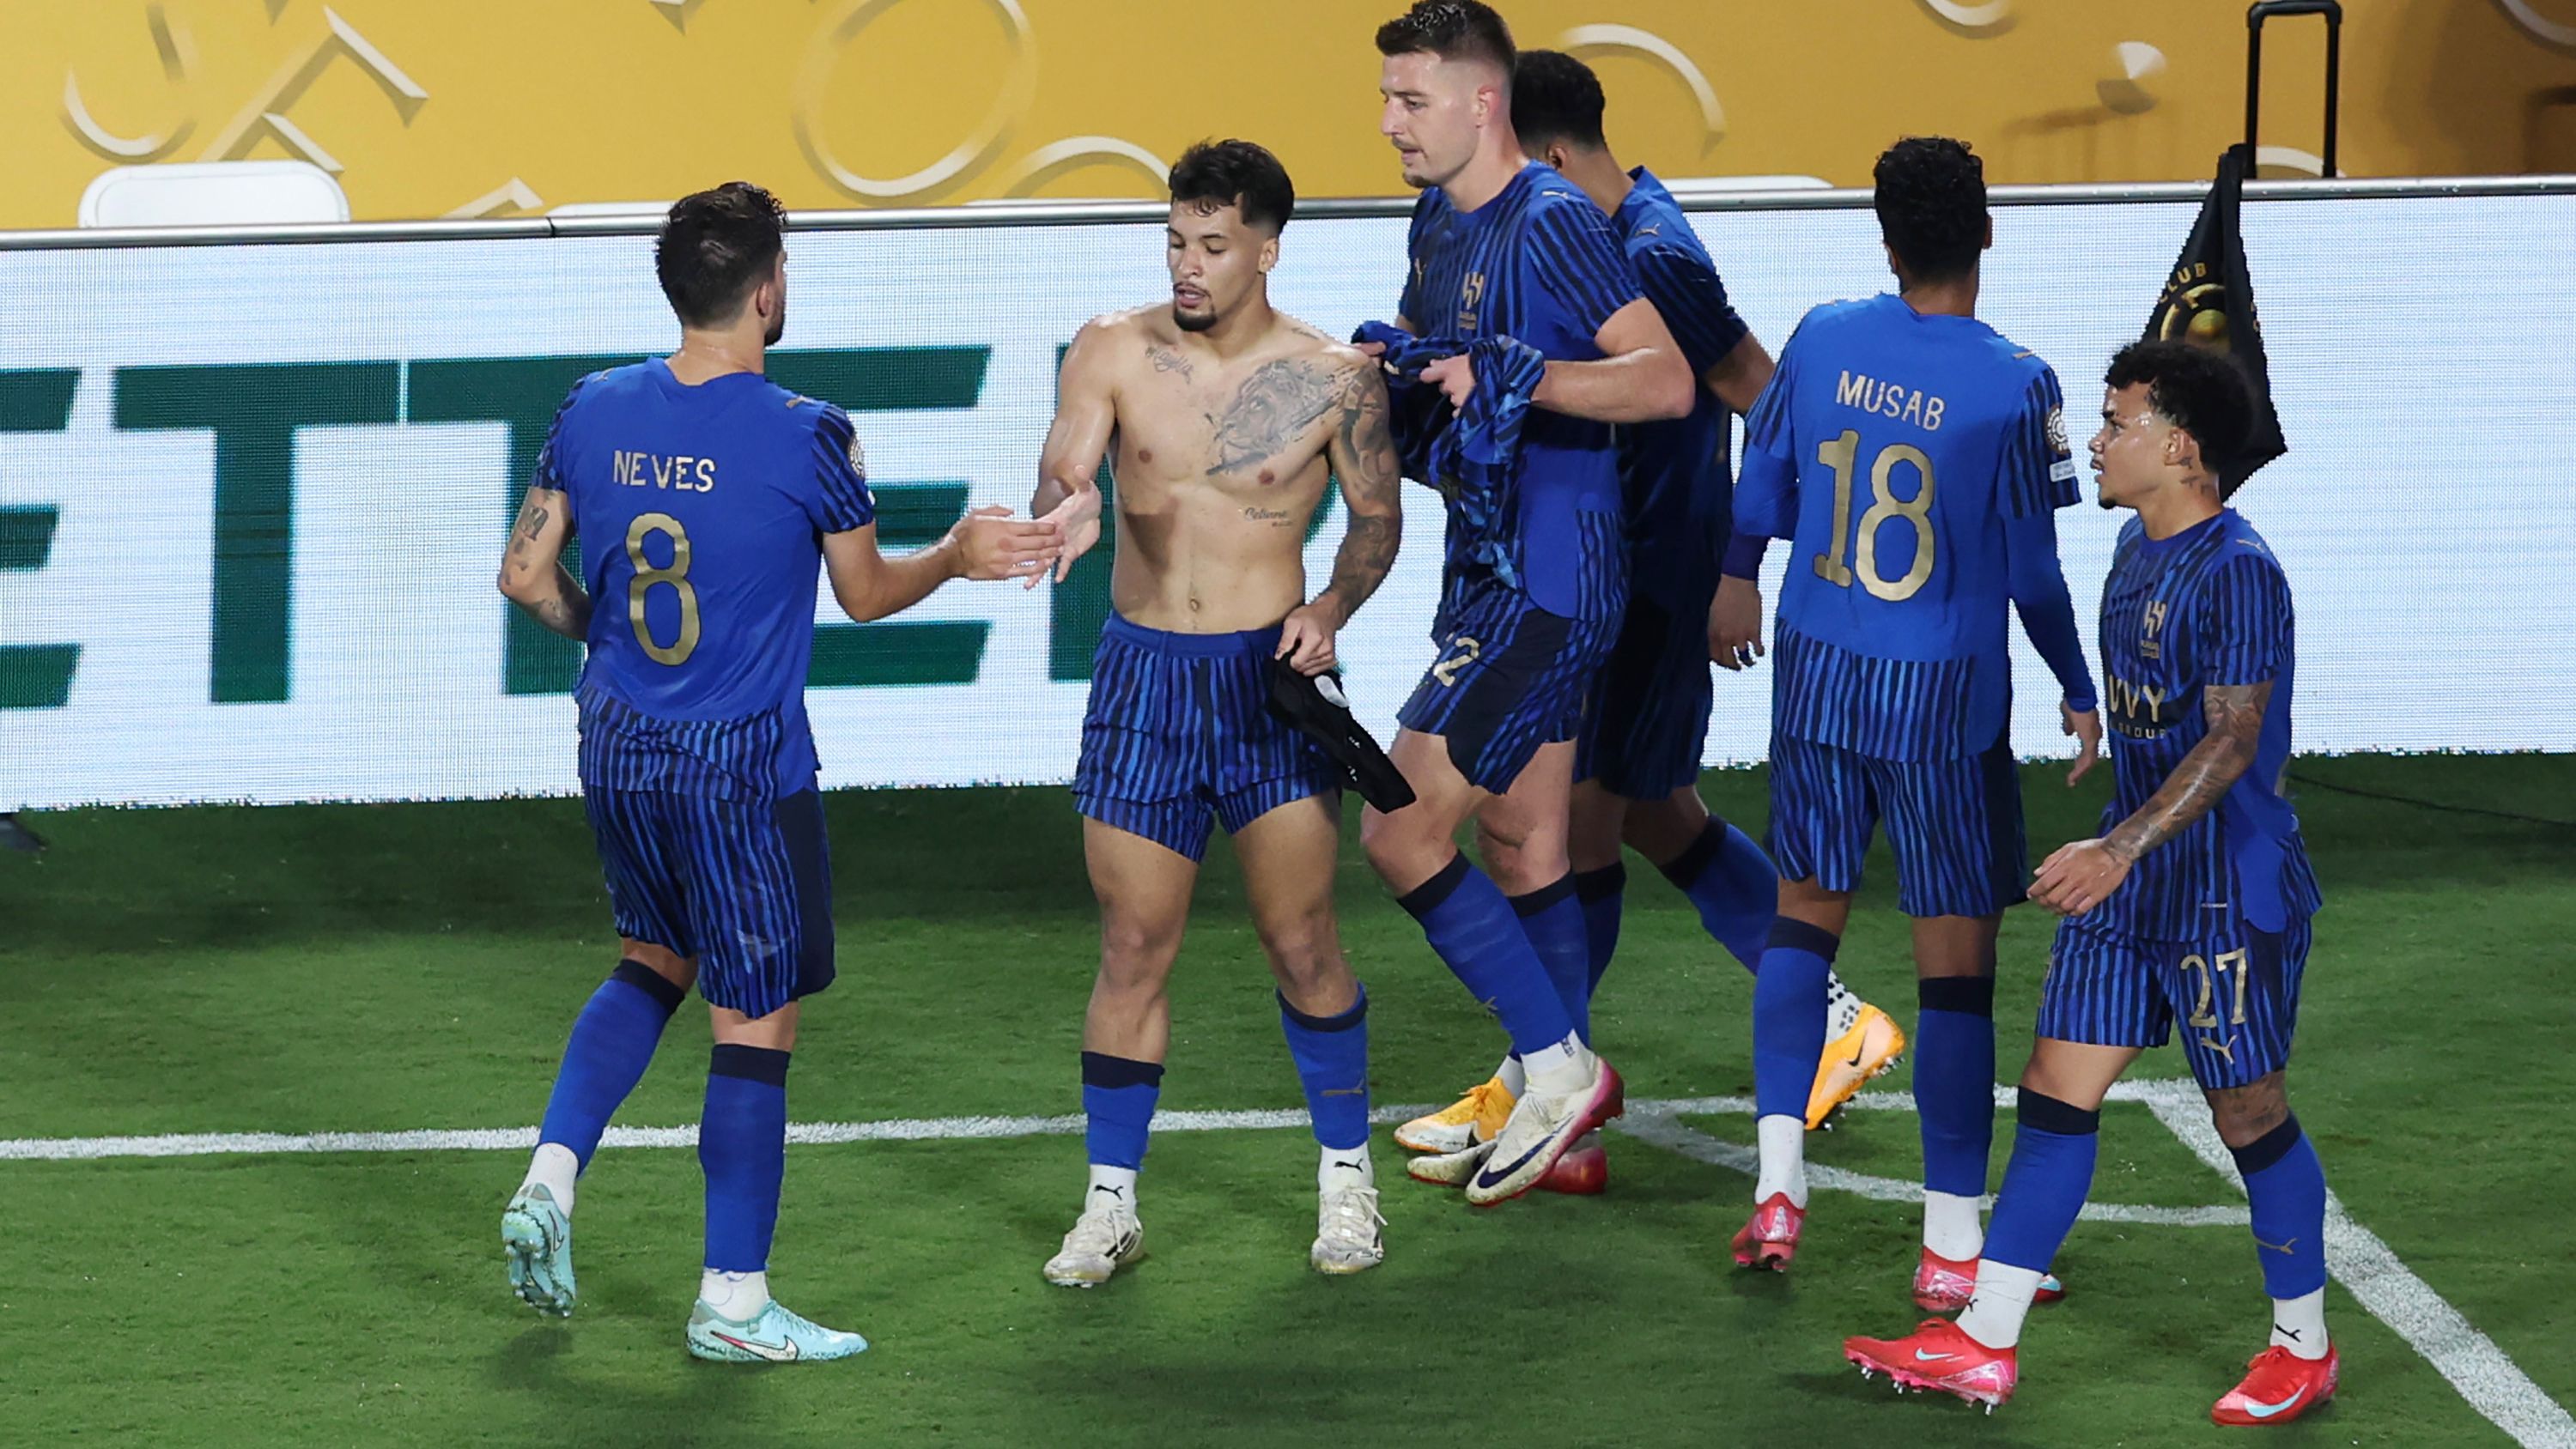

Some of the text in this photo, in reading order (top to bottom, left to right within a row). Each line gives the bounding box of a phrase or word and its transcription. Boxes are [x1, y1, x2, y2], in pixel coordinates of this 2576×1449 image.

[1835, 369, 1946, 432] MUSAB
[612, 449, 717, 494] NEVES
[1813, 428, 1935, 603] 18
[625, 512, 701, 667] 8
[2179, 947, 2248, 1029] 27
